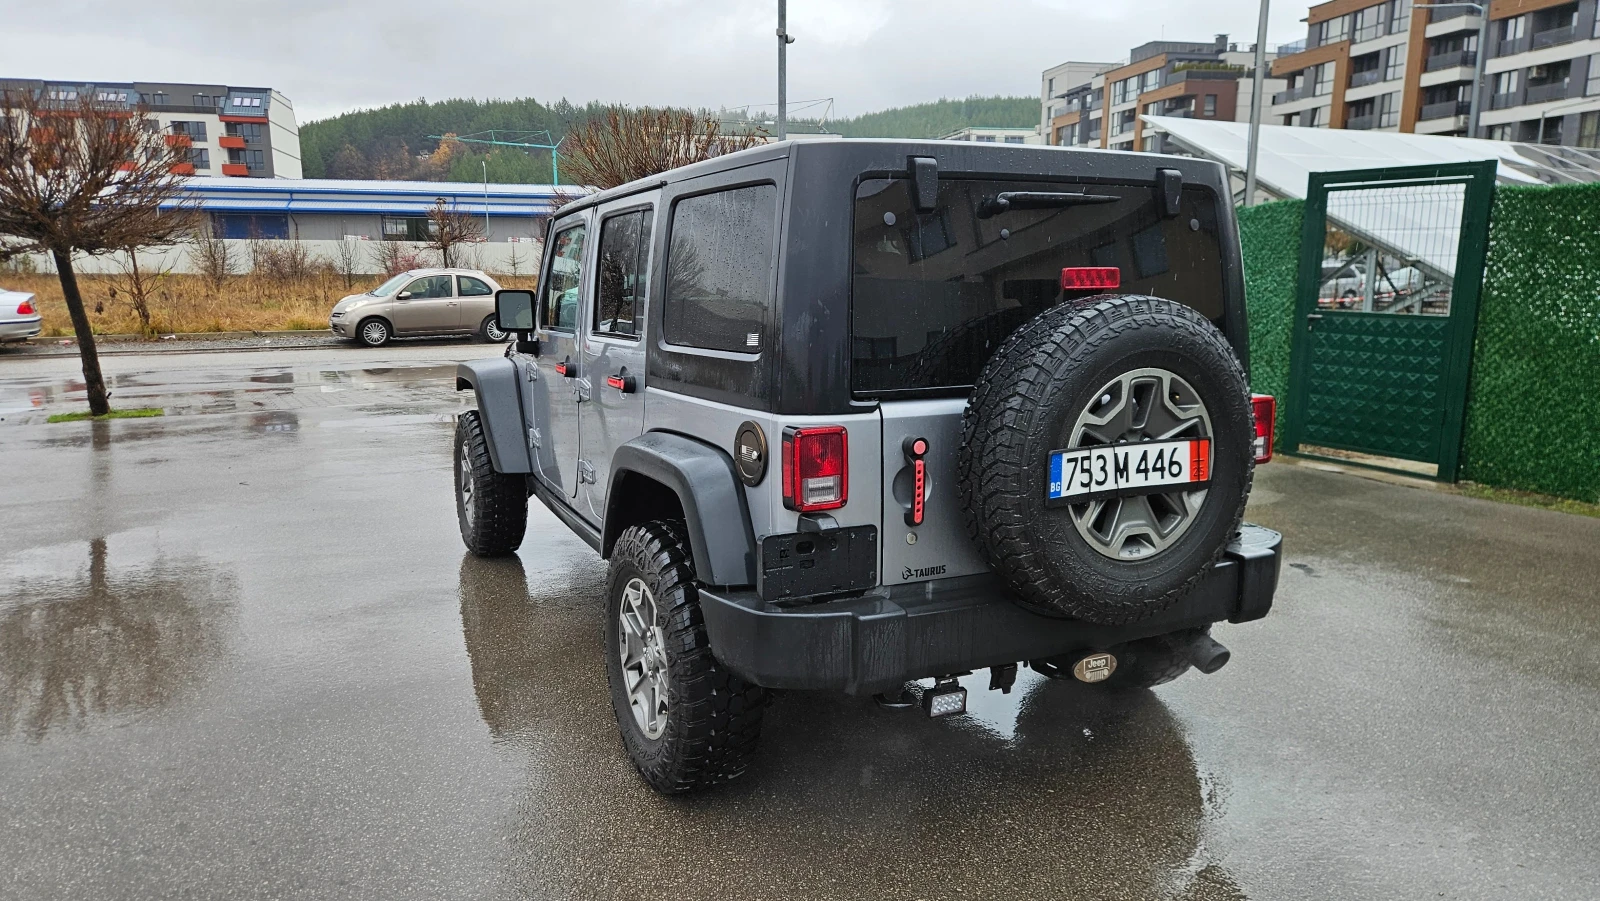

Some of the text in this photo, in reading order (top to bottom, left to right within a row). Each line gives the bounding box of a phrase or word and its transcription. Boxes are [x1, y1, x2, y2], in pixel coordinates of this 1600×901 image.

[1050, 481, 1061, 493] BG
[913, 564, 947, 578] TAURUS
[1087, 658, 1106, 668] Jeep
